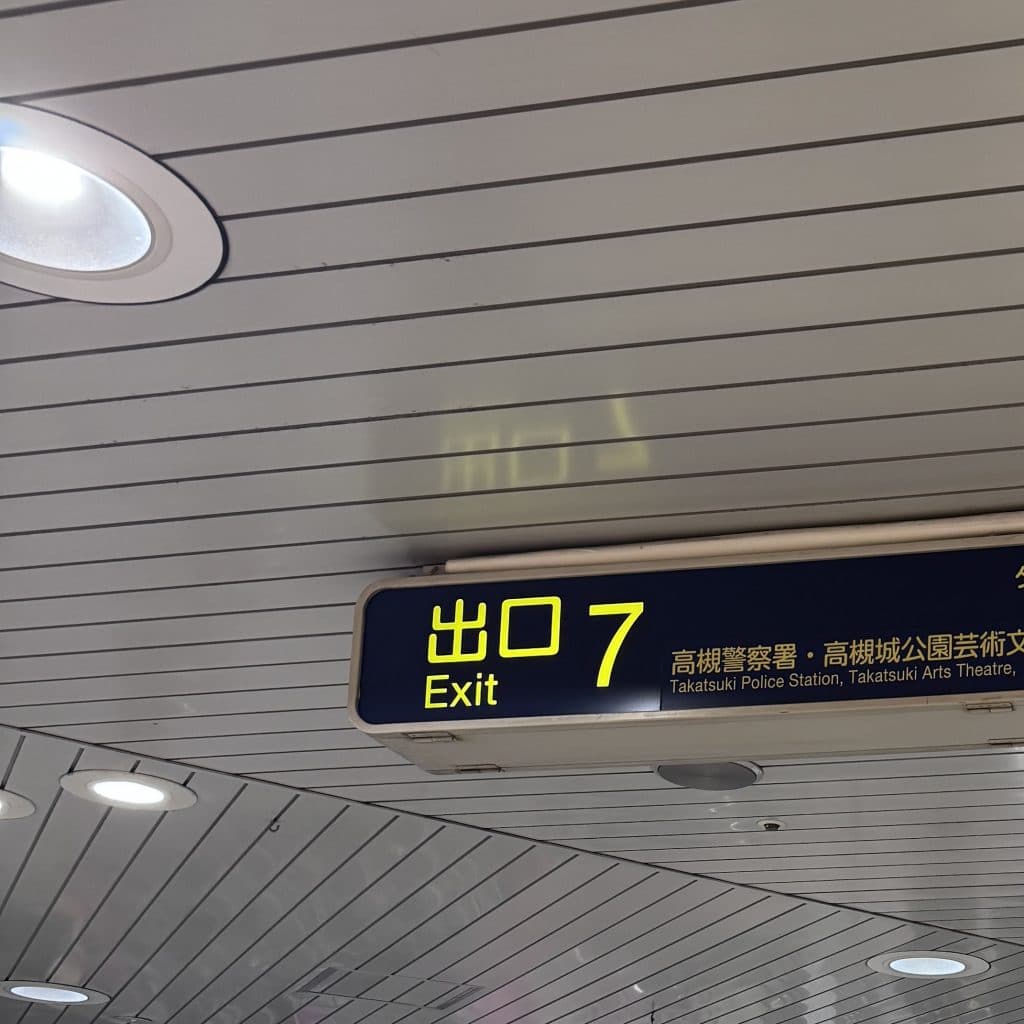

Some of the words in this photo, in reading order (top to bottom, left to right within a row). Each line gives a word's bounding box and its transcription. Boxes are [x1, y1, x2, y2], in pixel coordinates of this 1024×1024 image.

[428, 596, 561, 664] 出口
[588, 601, 644, 688] 7
[424, 672, 498, 709] Exit
[670, 678, 737, 694] Takatsuki
[741, 674, 784, 691] Police
[789, 672, 843, 689] Station,
[849, 667, 917, 685] Takatsuki
[921, 662, 952, 680] Arts
[956, 661, 1016, 680] Theatre,
